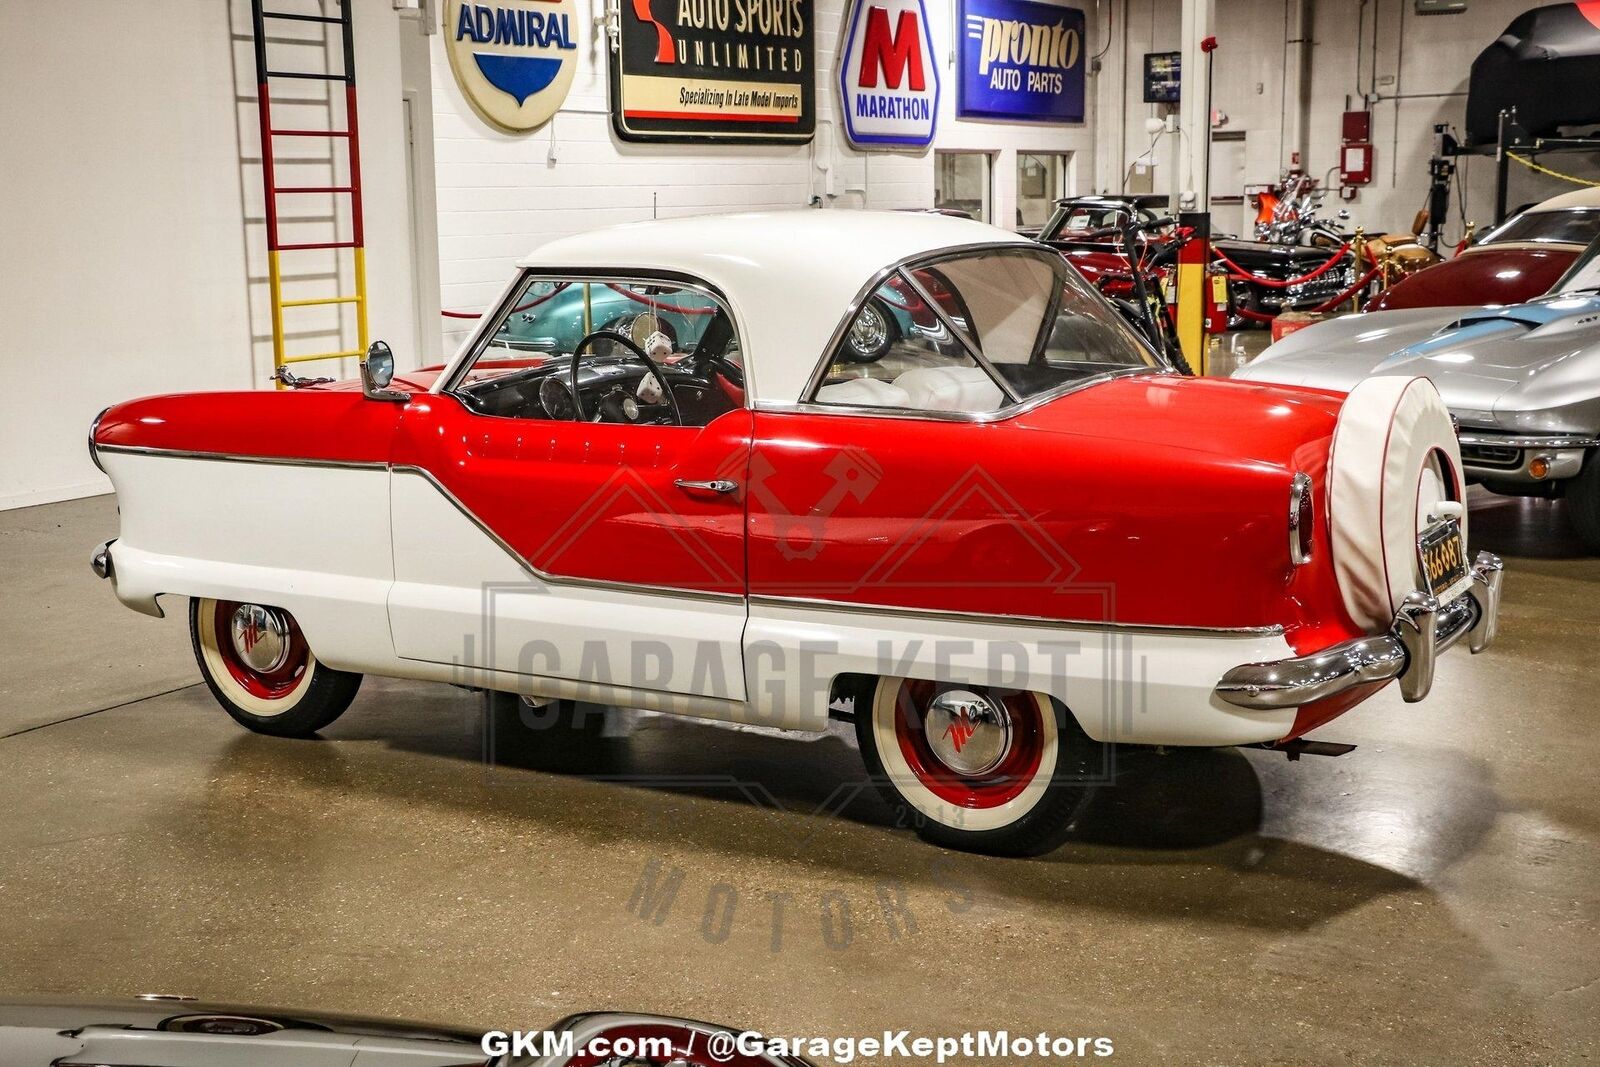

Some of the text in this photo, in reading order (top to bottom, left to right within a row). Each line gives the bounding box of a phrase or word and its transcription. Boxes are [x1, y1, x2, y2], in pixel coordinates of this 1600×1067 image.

[456, 3, 577, 49] ADMIRAL
[677, 0, 803, 38] AUTO SPORTS
[677, 39, 802, 73] UNLIMITED
[858, 6, 926, 91] M
[979, 16, 1080, 75] pronto
[679, 86, 799, 109] Specializing In Late Model Imports
[989, 67, 1063, 95] AUTO PARTS
[856, 93, 930, 121] MARATHON
